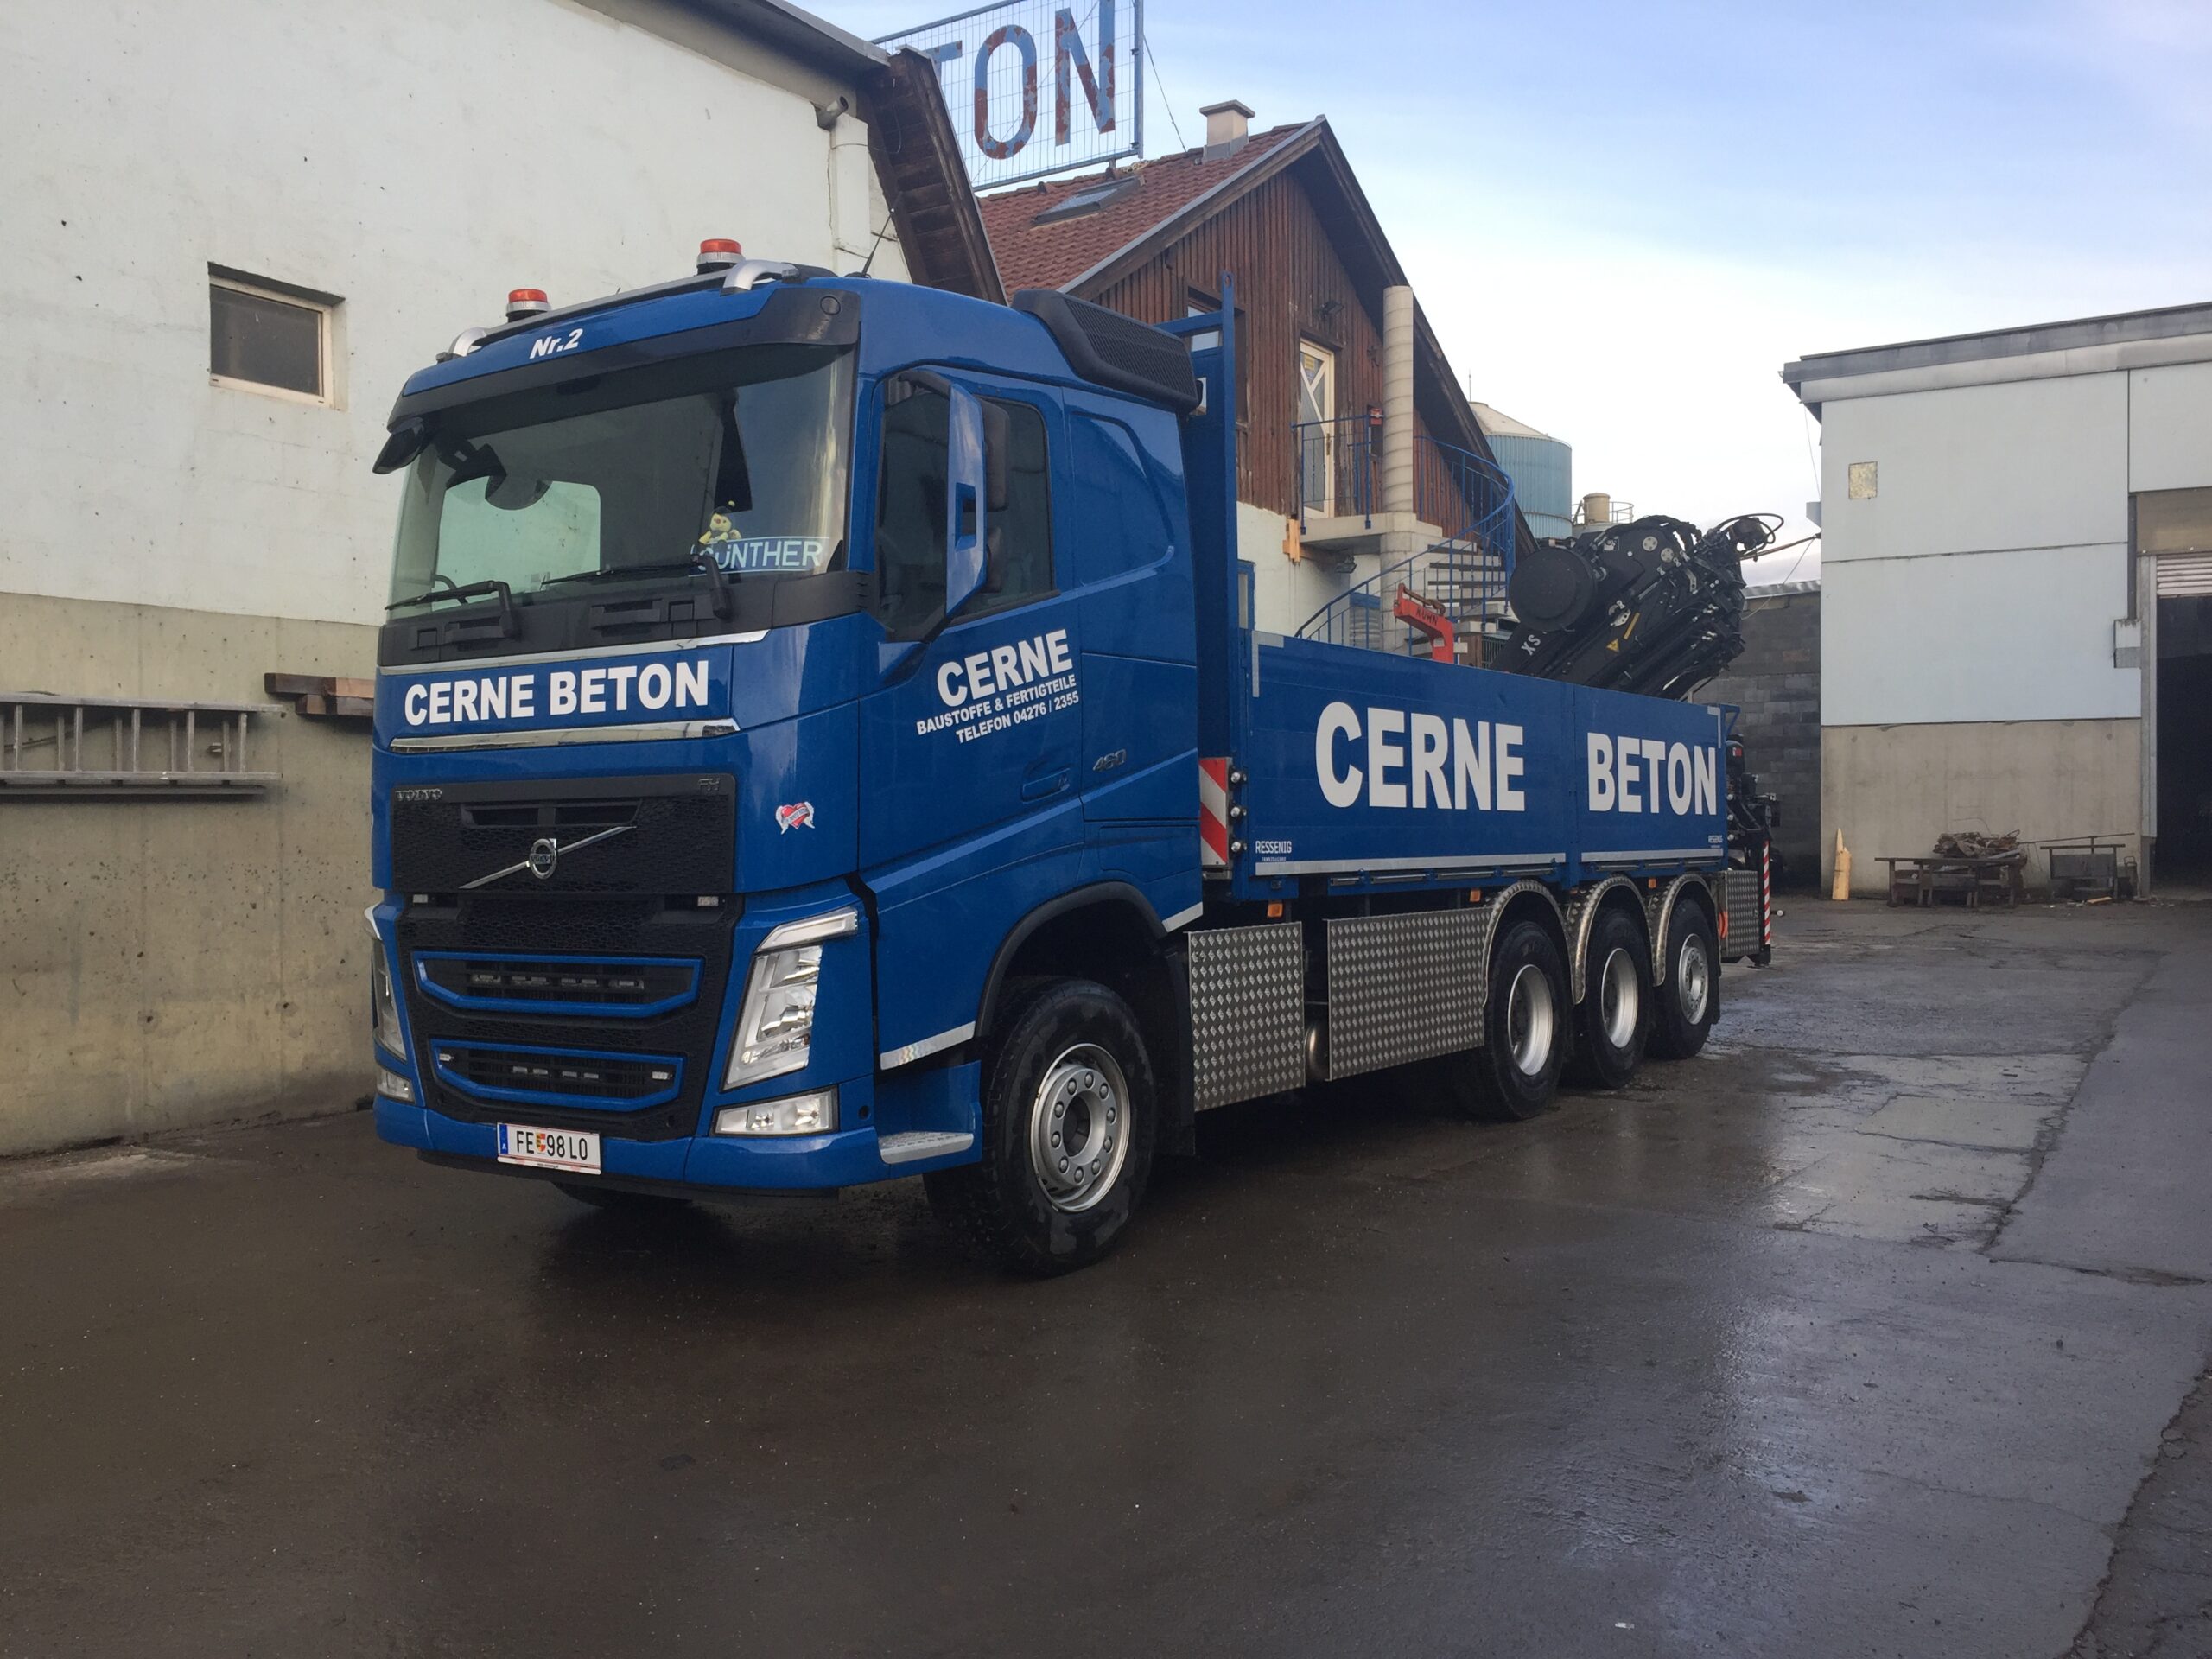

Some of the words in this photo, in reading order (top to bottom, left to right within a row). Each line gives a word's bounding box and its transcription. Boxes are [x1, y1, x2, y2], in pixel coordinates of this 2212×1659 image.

[529, 327, 584, 359] Nr.2
[404, 674, 535, 726] CERNE
[550, 660, 709, 715] BETON
[937, 628, 1073, 707] CERNE
[916, 701, 993, 735] BAUSTOFFE
[994, 697, 1004, 712] &
[1005, 674, 1077, 709] FERTIGTEILE
[955, 713, 1012, 744] TELEFON
[1013, 702, 1047, 725] 04276
[1053, 690, 1079, 711] 2355
[1315, 701, 1525, 812] CERNE
[1586, 731, 1717, 816] BETON
[1255, 840, 1293, 855] RESSENIG
[516, 1130, 535, 1154] FE
